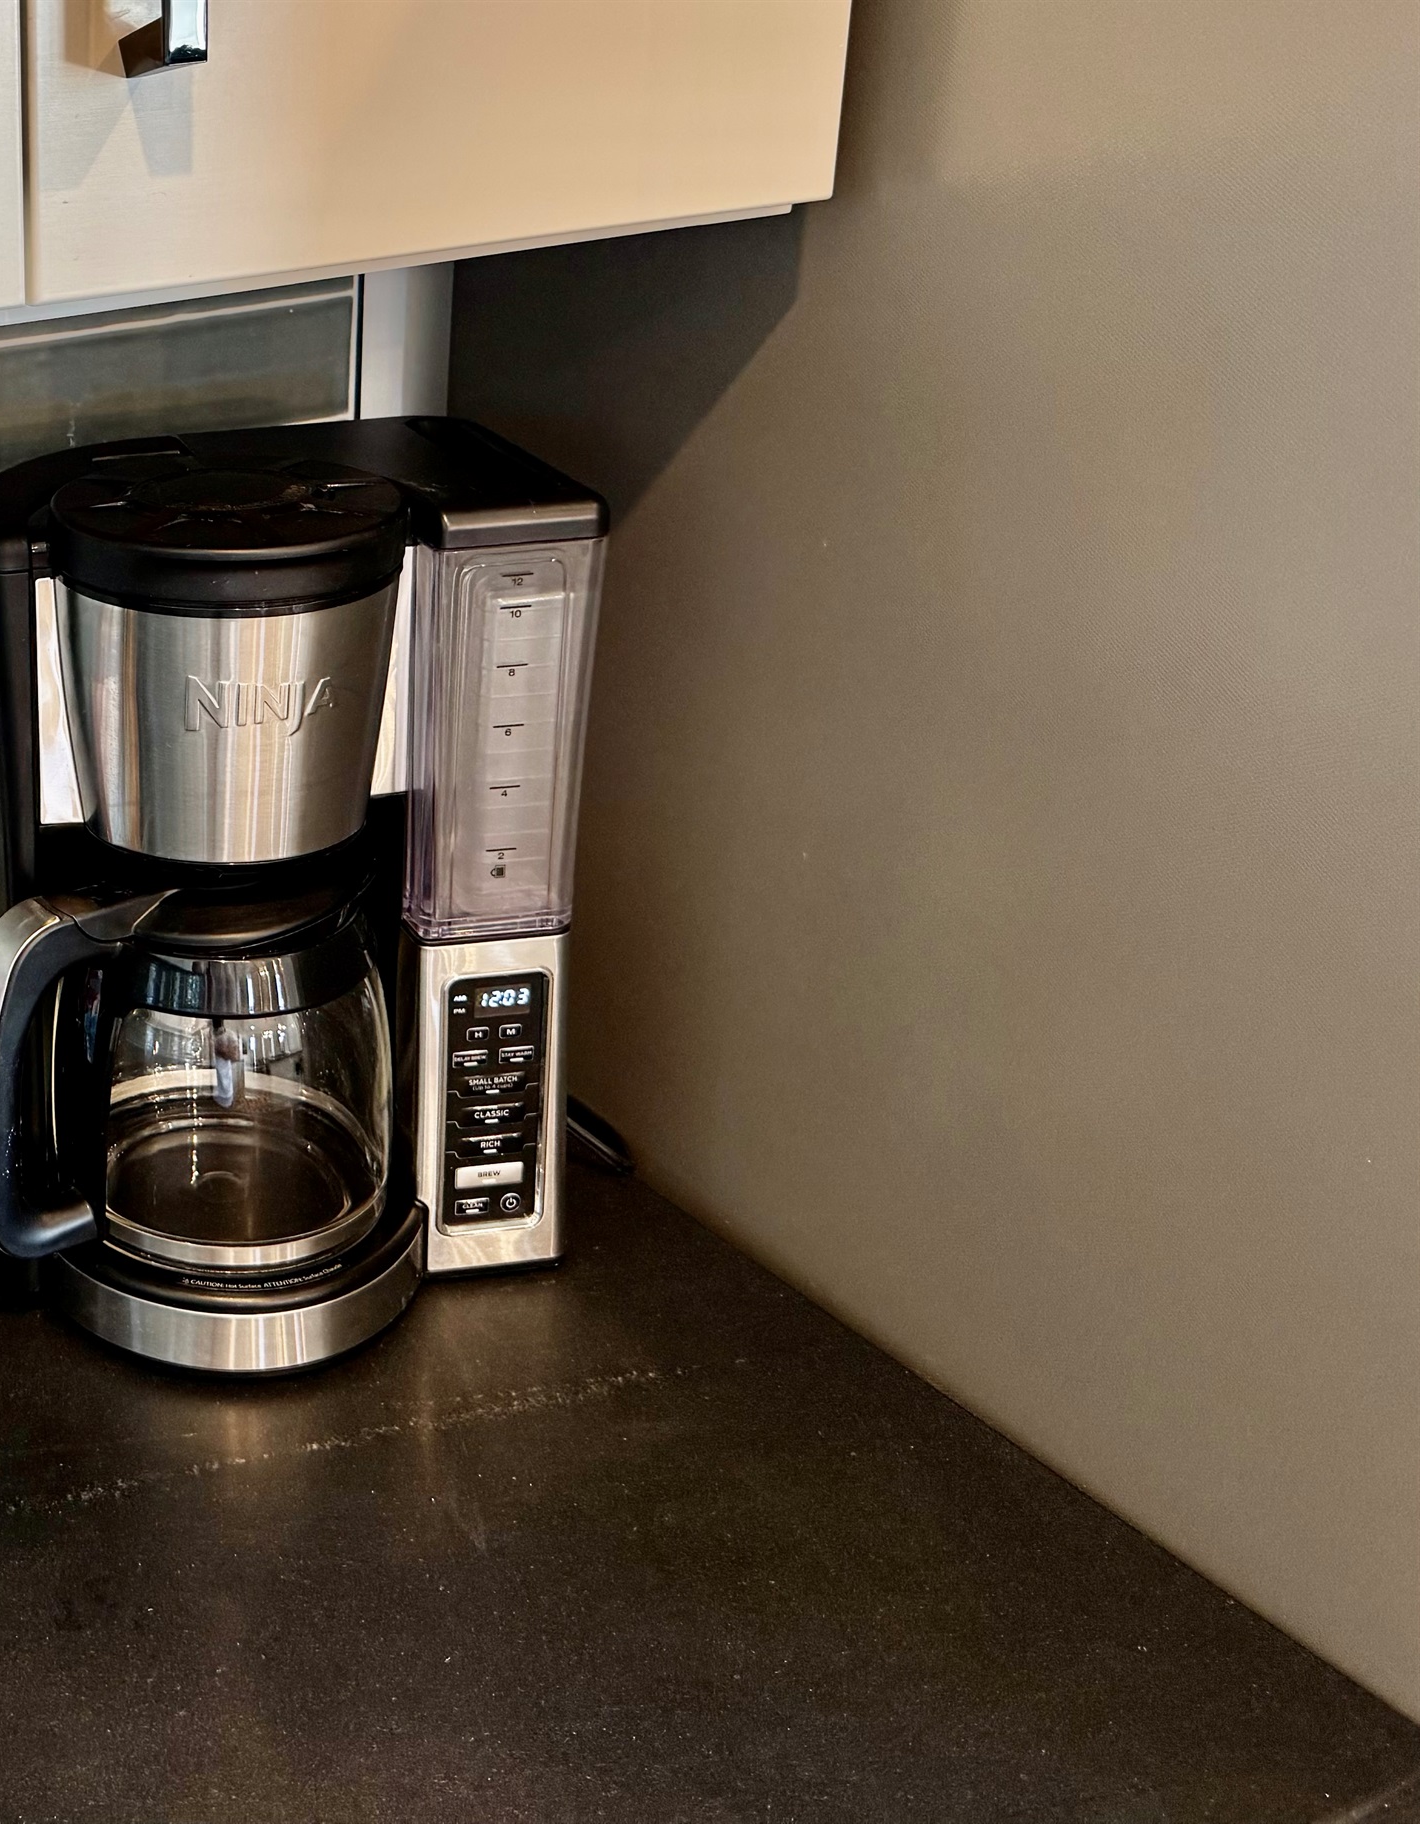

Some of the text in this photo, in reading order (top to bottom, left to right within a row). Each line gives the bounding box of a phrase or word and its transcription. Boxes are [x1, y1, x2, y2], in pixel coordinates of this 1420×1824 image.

[511, 577, 524, 586] 12
[509, 609, 522, 618] 10
[508, 668, 515, 677] 8
[184, 674, 334, 737] NINJA
[504, 728, 512, 737] 6
[500, 789, 508, 797] 4
[497, 852, 505, 860] 2
[480, 987, 530, 1008] 12:03
[474, 1031, 483, 1039] H
[506, 1028, 516, 1036] M
[468, 1075, 518, 1086] SMALL BATCH
[474, 1109, 510, 1119] CLASSIC
[480, 1140, 501, 1149] RICH
[477, 1170, 501, 1178] BREW
